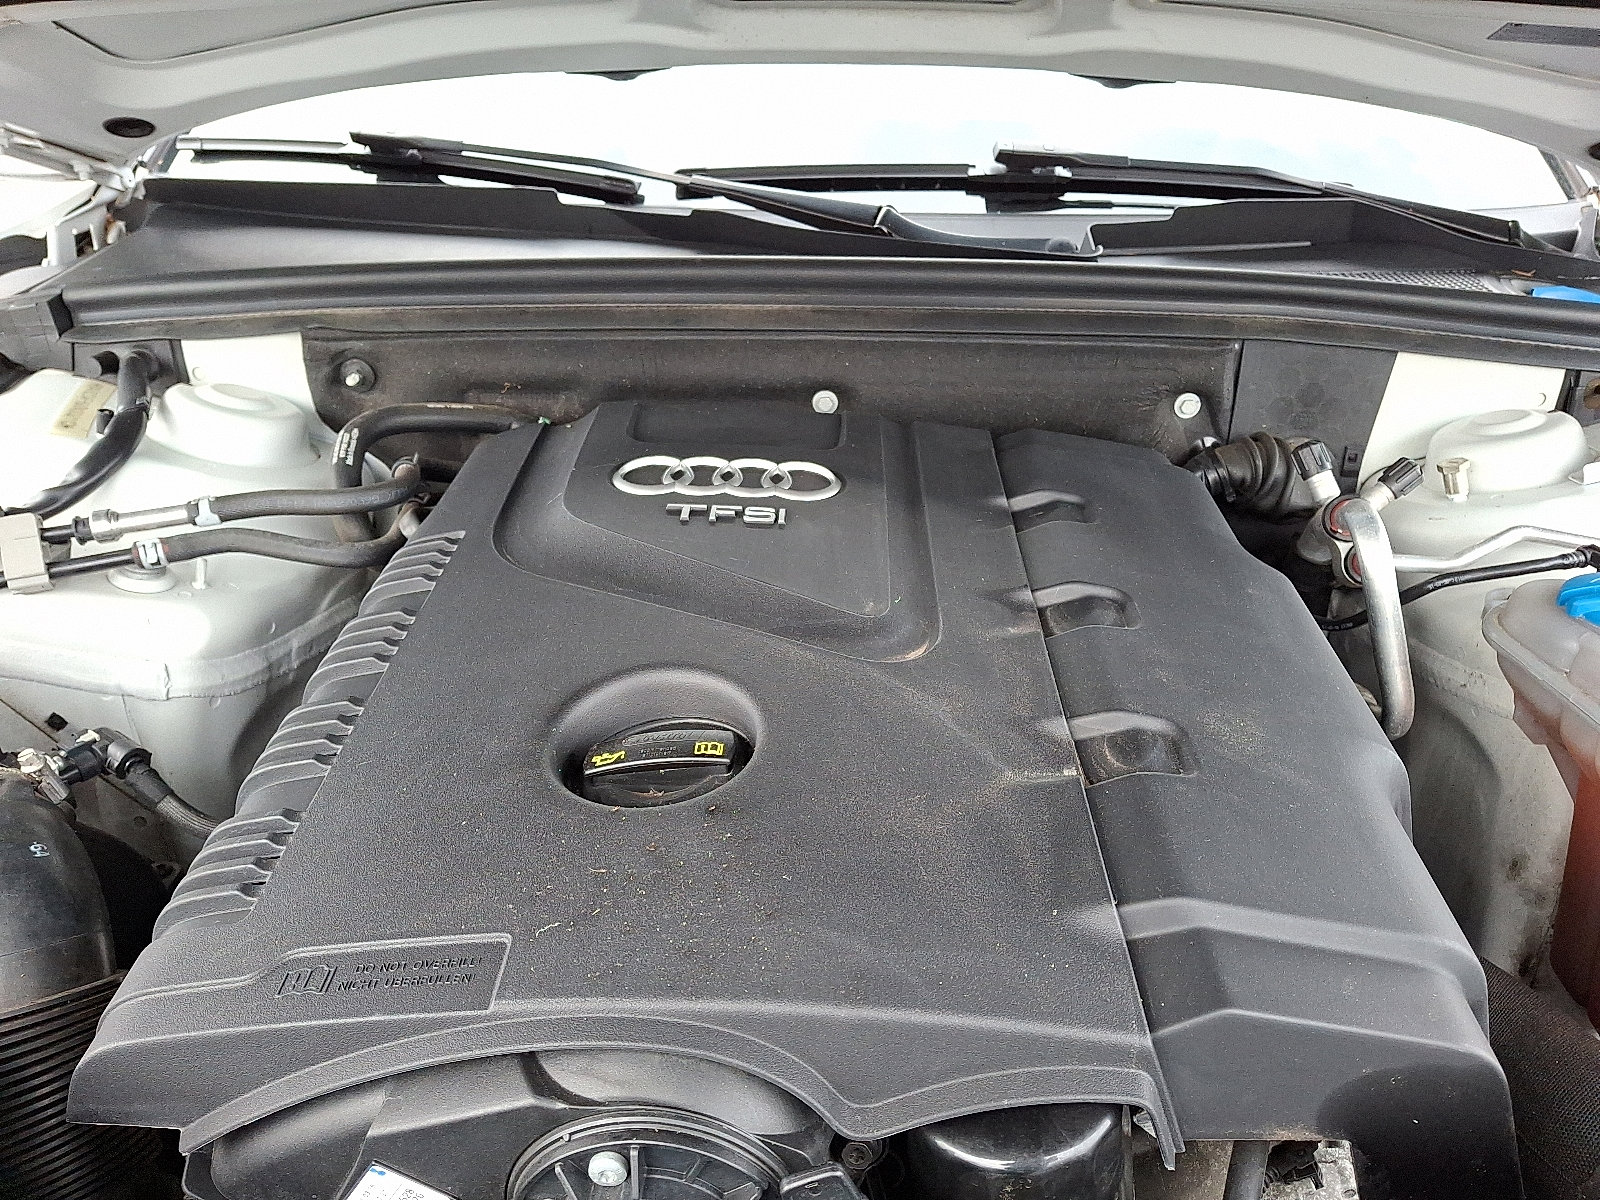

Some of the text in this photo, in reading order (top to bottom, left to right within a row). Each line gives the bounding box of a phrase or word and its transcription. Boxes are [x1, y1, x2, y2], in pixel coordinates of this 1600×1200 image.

[666, 503, 787, 526] TFSI
[355, 963, 375, 974] DO
[380, 961, 407, 973] NOT
[337, 978, 381, 992] NICHT
